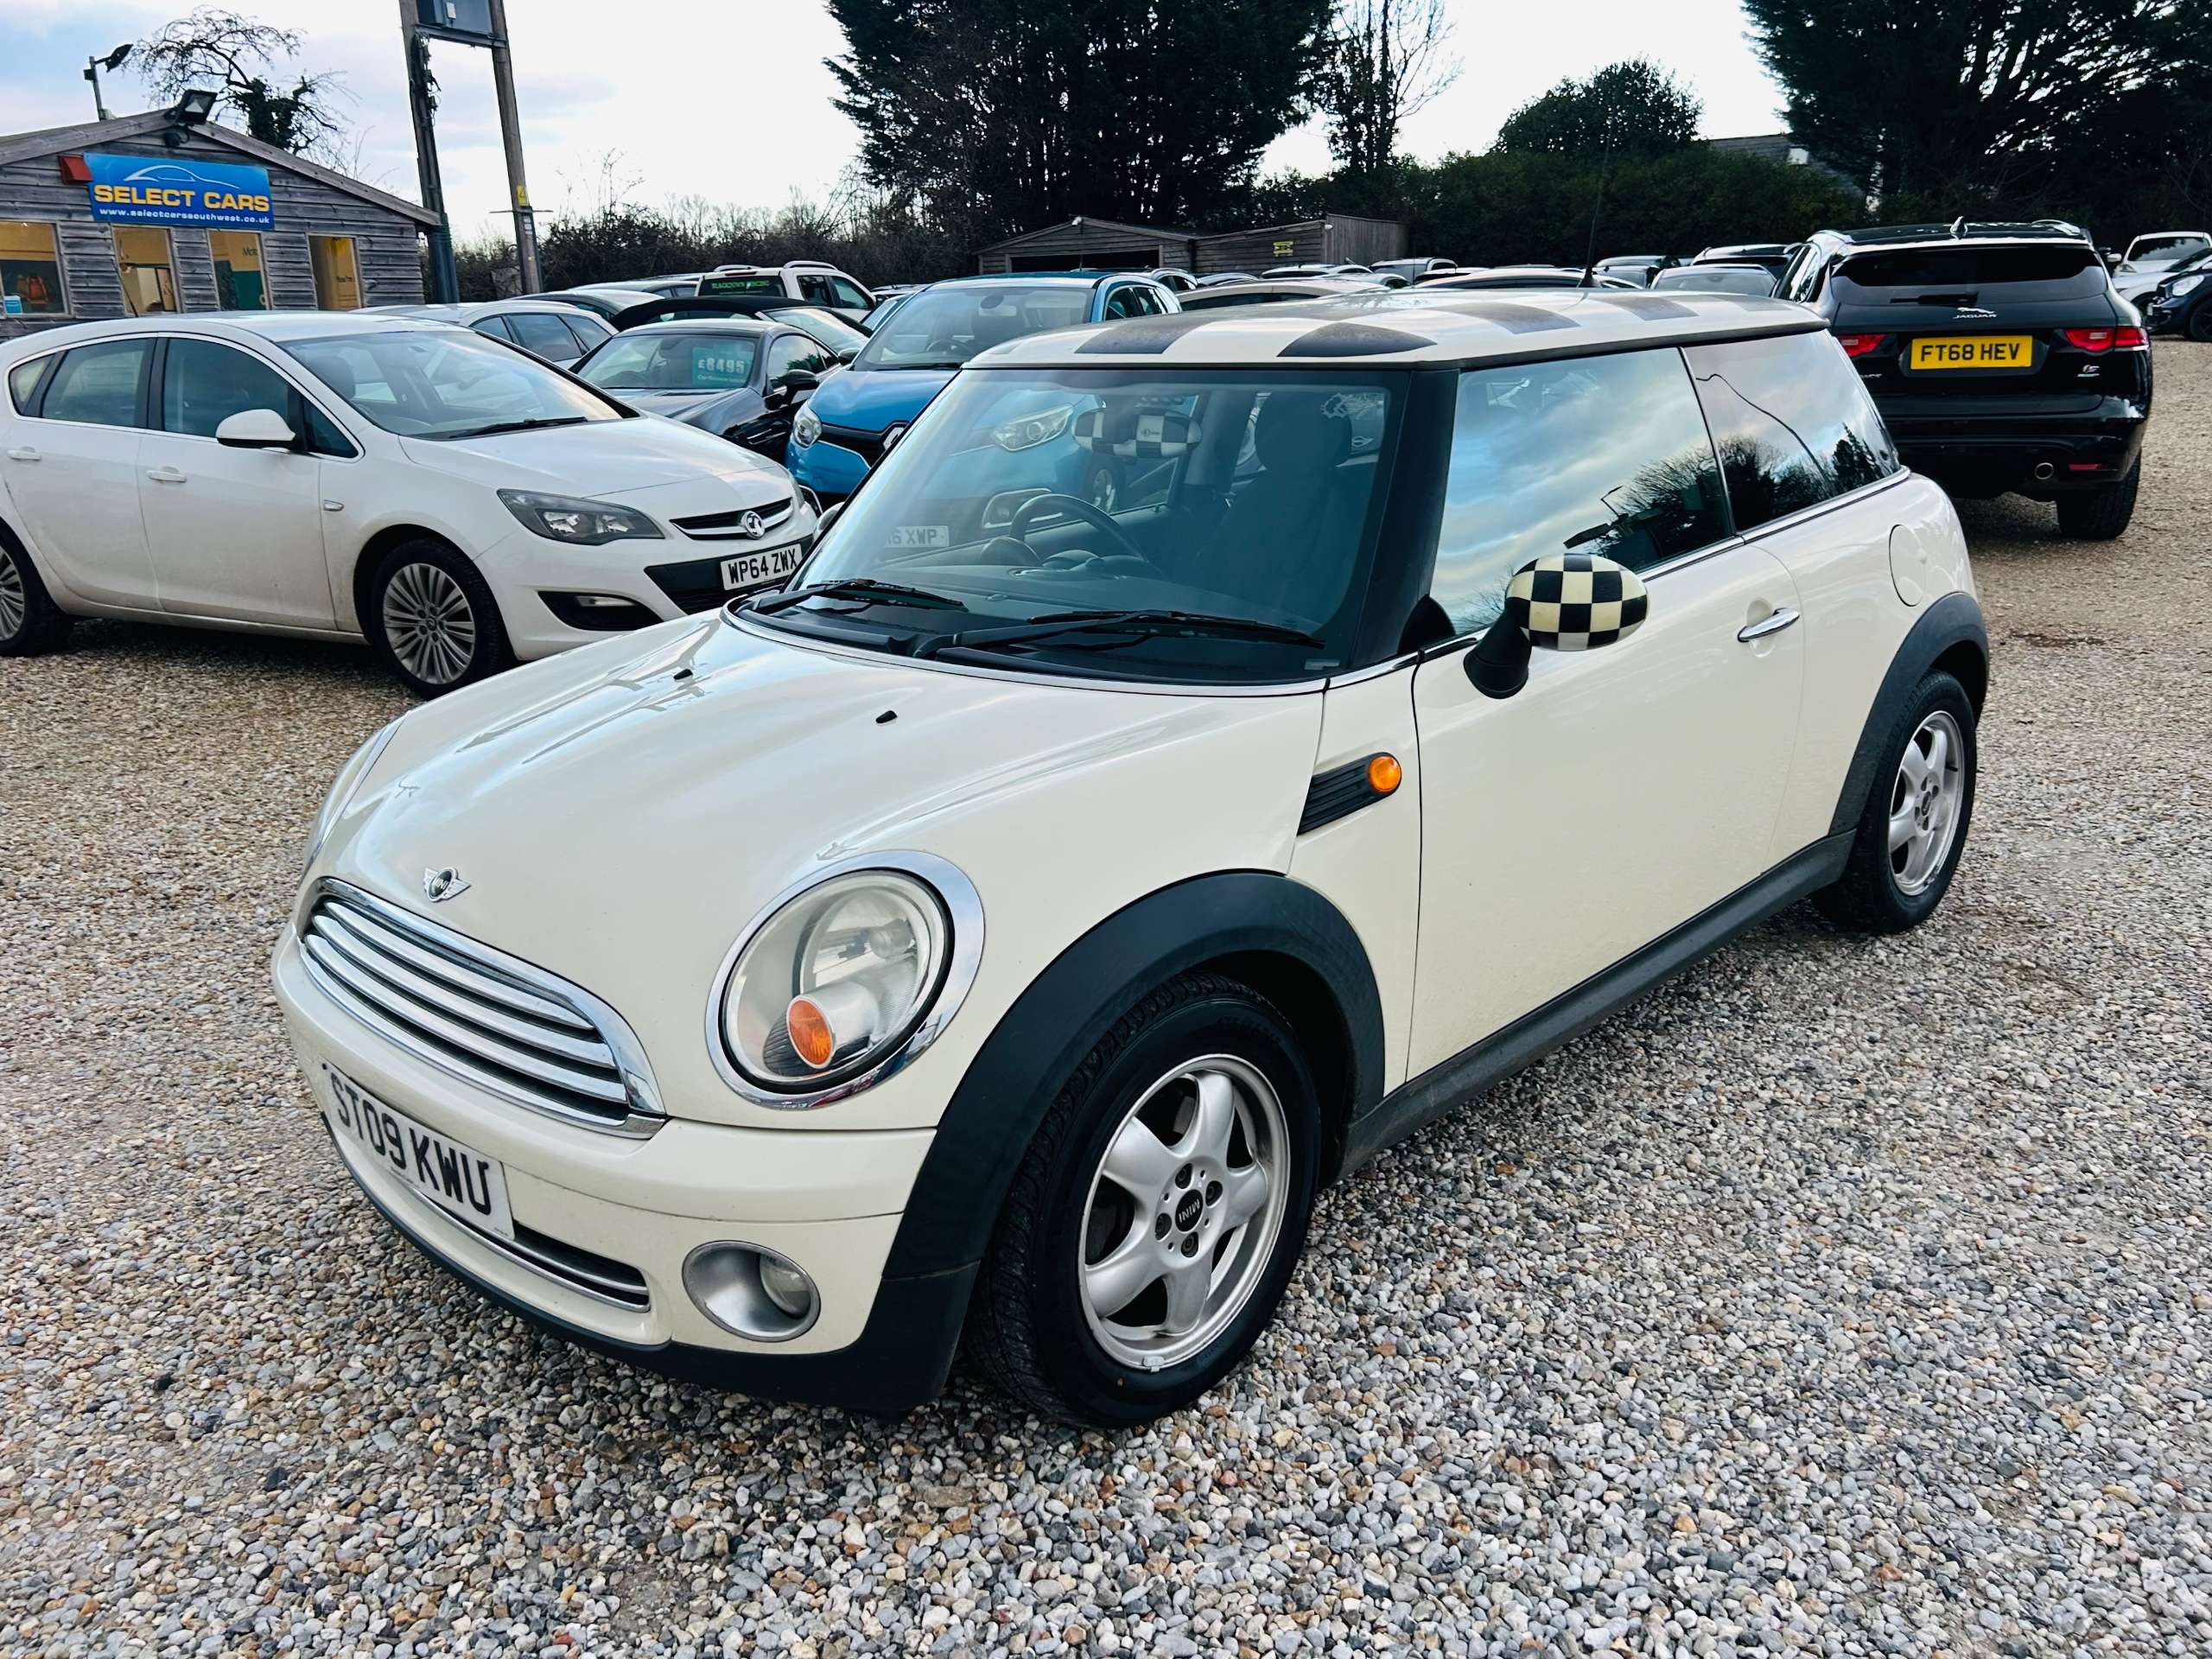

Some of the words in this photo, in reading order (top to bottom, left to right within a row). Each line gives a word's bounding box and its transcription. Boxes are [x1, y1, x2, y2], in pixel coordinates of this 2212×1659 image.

[94, 184, 195, 207] SELECT
[203, 192, 270, 213] CARS
[99, 208, 270, 224] www.selectcarssouthwest.co.uk
[1920, 344, 1974, 362] FT68
[1980, 343, 2020, 360] HEV
[697, 358, 745, 374] £8495
[906, 528, 937, 545] XWP
[728, 556, 769, 584] WP64
[771, 548, 798, 574] ZWX
[331, 1072, 407, 1171] ST09
[409, 1128, 492, 1216] KWU
[1178, 1198, 1201, 1224] MINI
